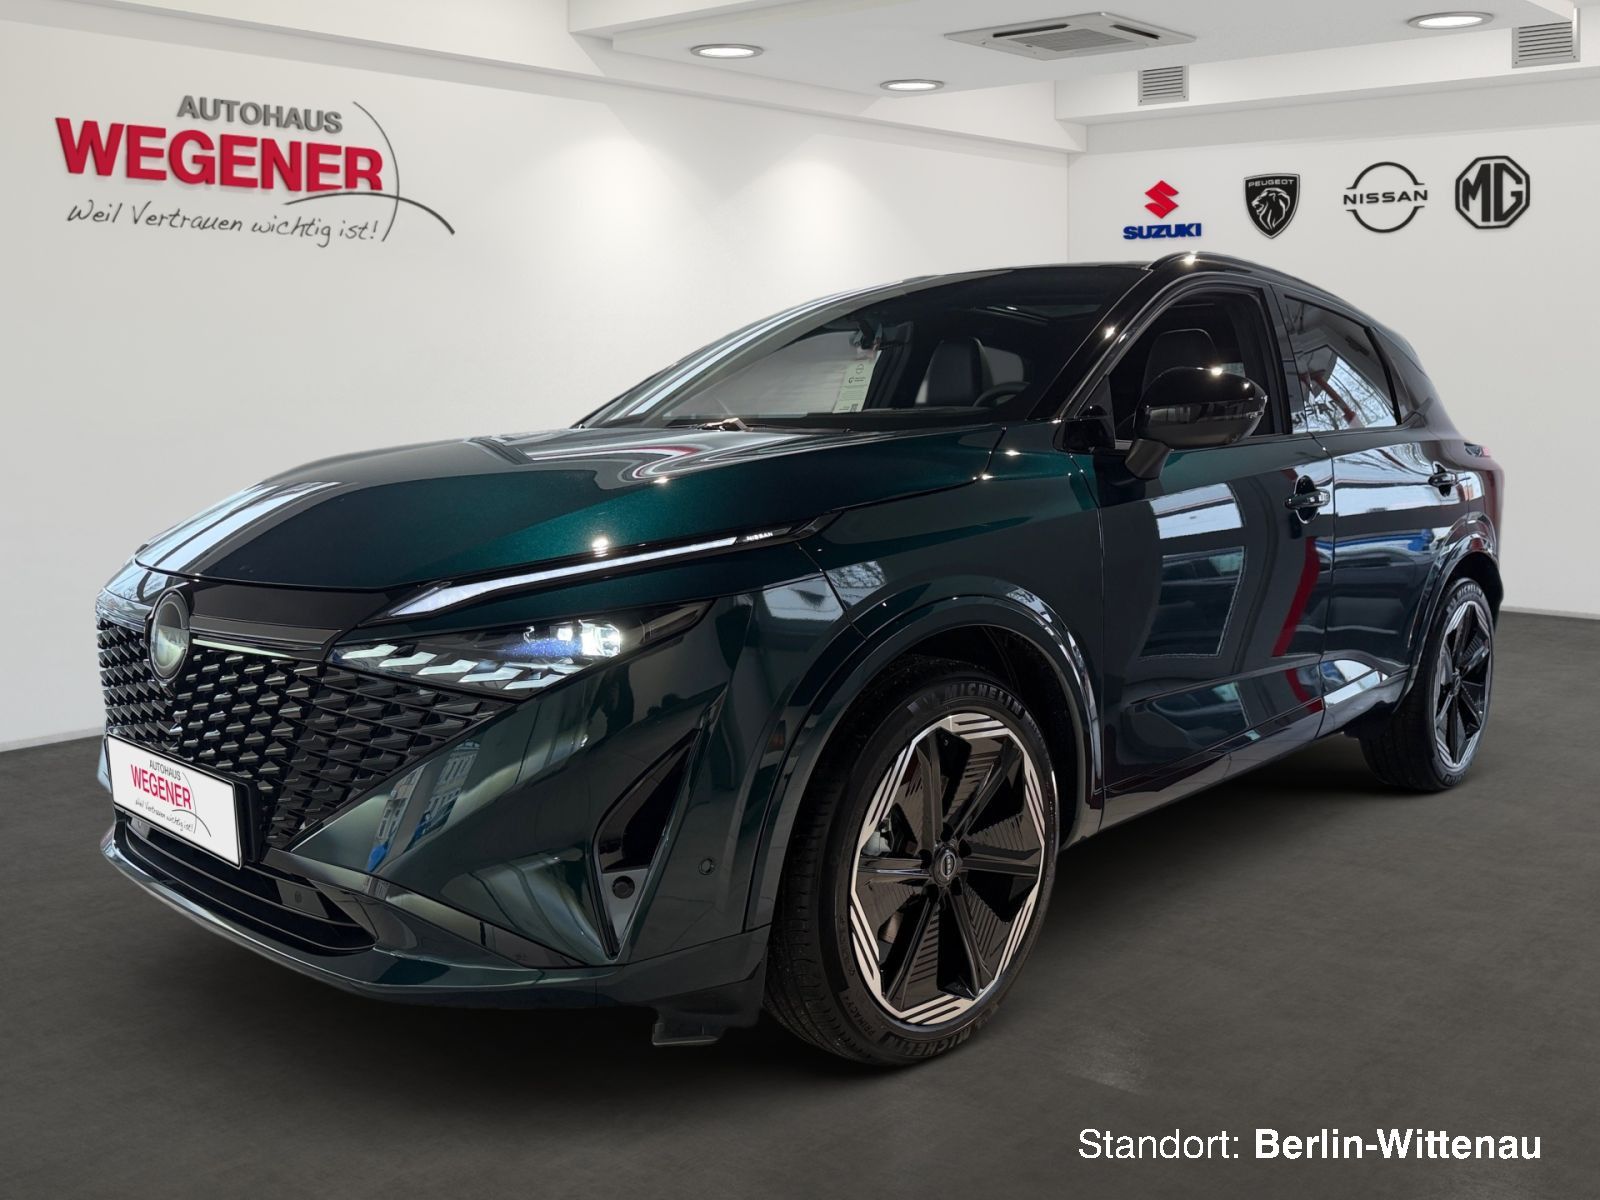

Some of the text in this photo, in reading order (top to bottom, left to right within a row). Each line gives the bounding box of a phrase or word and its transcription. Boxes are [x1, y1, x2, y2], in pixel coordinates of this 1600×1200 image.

[176, 95, 342, 134] AUTOHAUS
[55, 117, 383, 193] WEGENER
[1248, 178, 1295, 188] PEUGEOT
[1343, 189, 1428, 205] NISSAN
[1460, 162, 1524, 223] MG
[67, 199, 379, 248] Weil Vertrauen wichtig ist!
[1122, 223, 1202, 240] SUZUKI
[944, 683, 1023, 716] MICHELIN
[130, 764, 191, 809] WEGENER
[149, 760, 181, 780] AUTOHAUS
